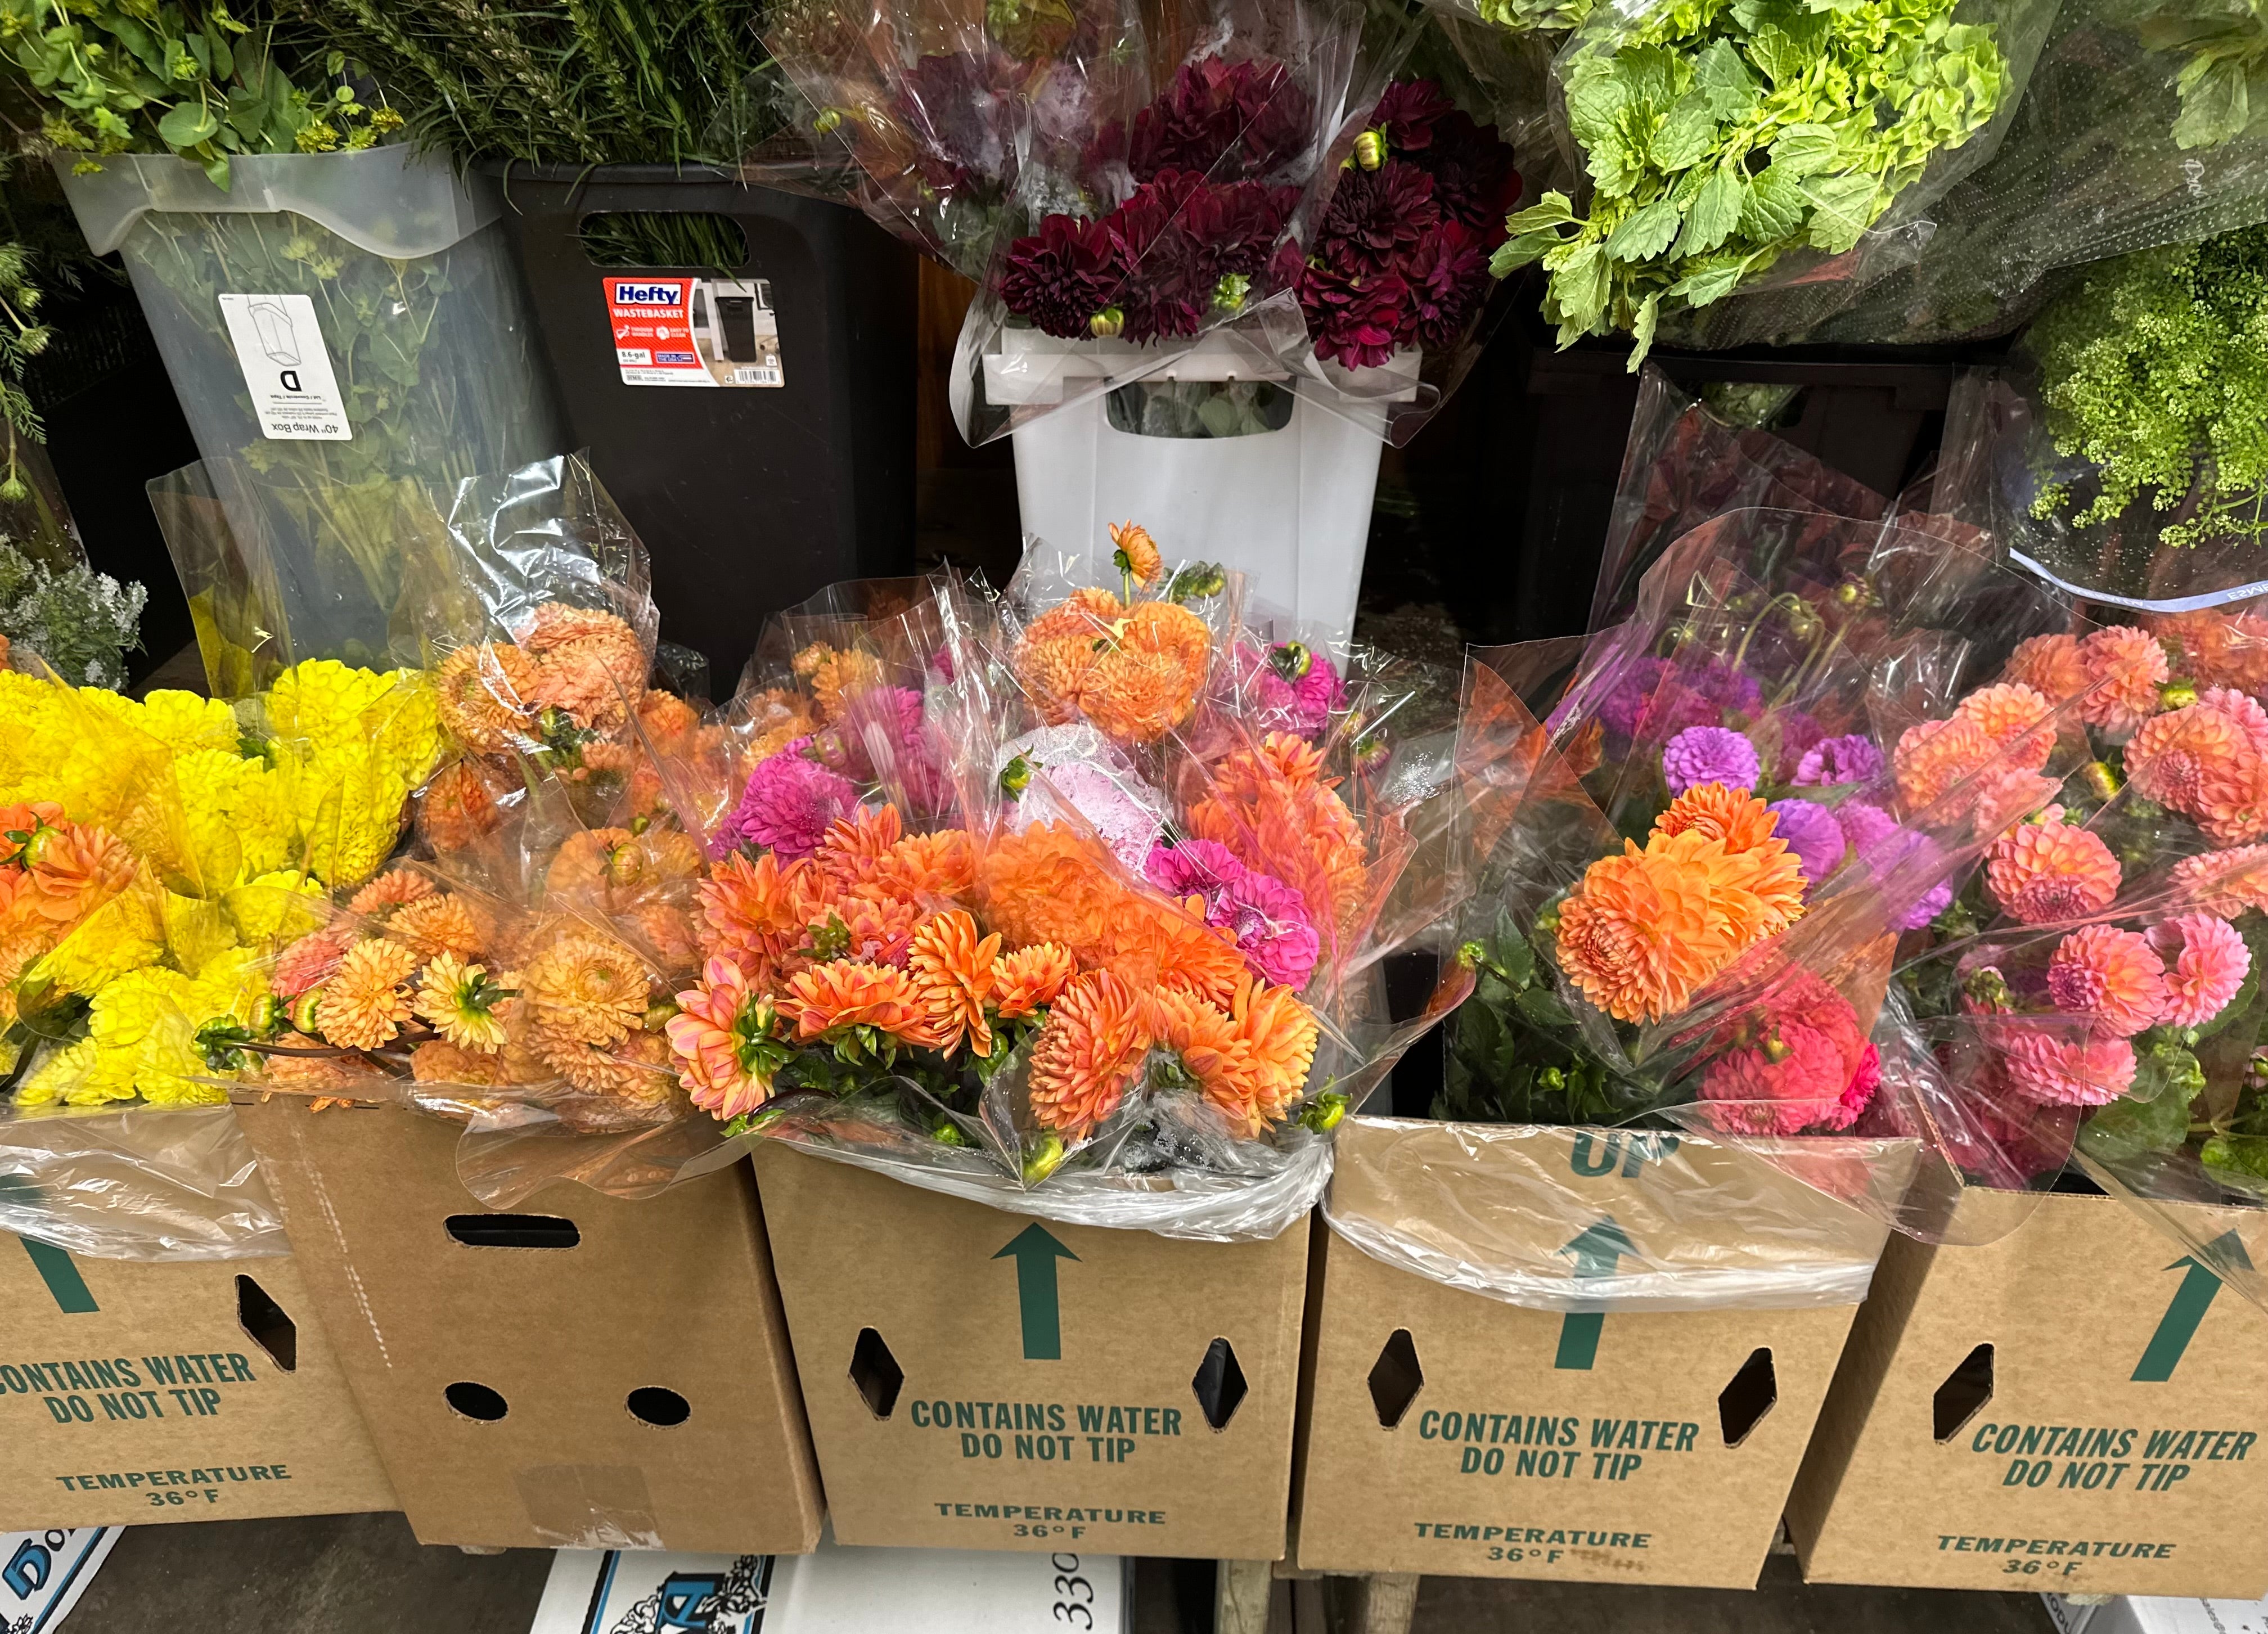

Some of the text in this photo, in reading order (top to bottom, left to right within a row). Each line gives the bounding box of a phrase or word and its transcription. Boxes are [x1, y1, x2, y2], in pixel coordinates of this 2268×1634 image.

[619, 286, 678, 305] Hefty
[613, 308, 684, 319] WASTEBASKET
[280, 370, 302, 391] D
[271, 422, 339, 434] 40" Wrap Box
[1571, 1131, 1680, 1178] UP
[141, 1353, 257, 1385] WATER
[43, 1388, 222, 1424] DO NOT TIP
[911, 1400, 1182, 1435] CONTAINS WATER
[1419, 1410, 1699, 1452] CONTAINS WATER
[1972, 1423, 2258, 1461] CONTAINS WATER
[961, 1433, 1135, 1463] DO NOT TIP
[56, 1464, 292, 1491] TEMPERATURE
[1461, 1447, 1642, 1481] DO NOT TIP
[2002, 1459, 2191, 1491] DO NOT TIP
[934, 1502, 1166, 1525] TEMPERATURE
[1414, 1523, 1653, 1549] TEMPERATURE
[1937, 1535, 2177, 1559] TEMPERATURE
